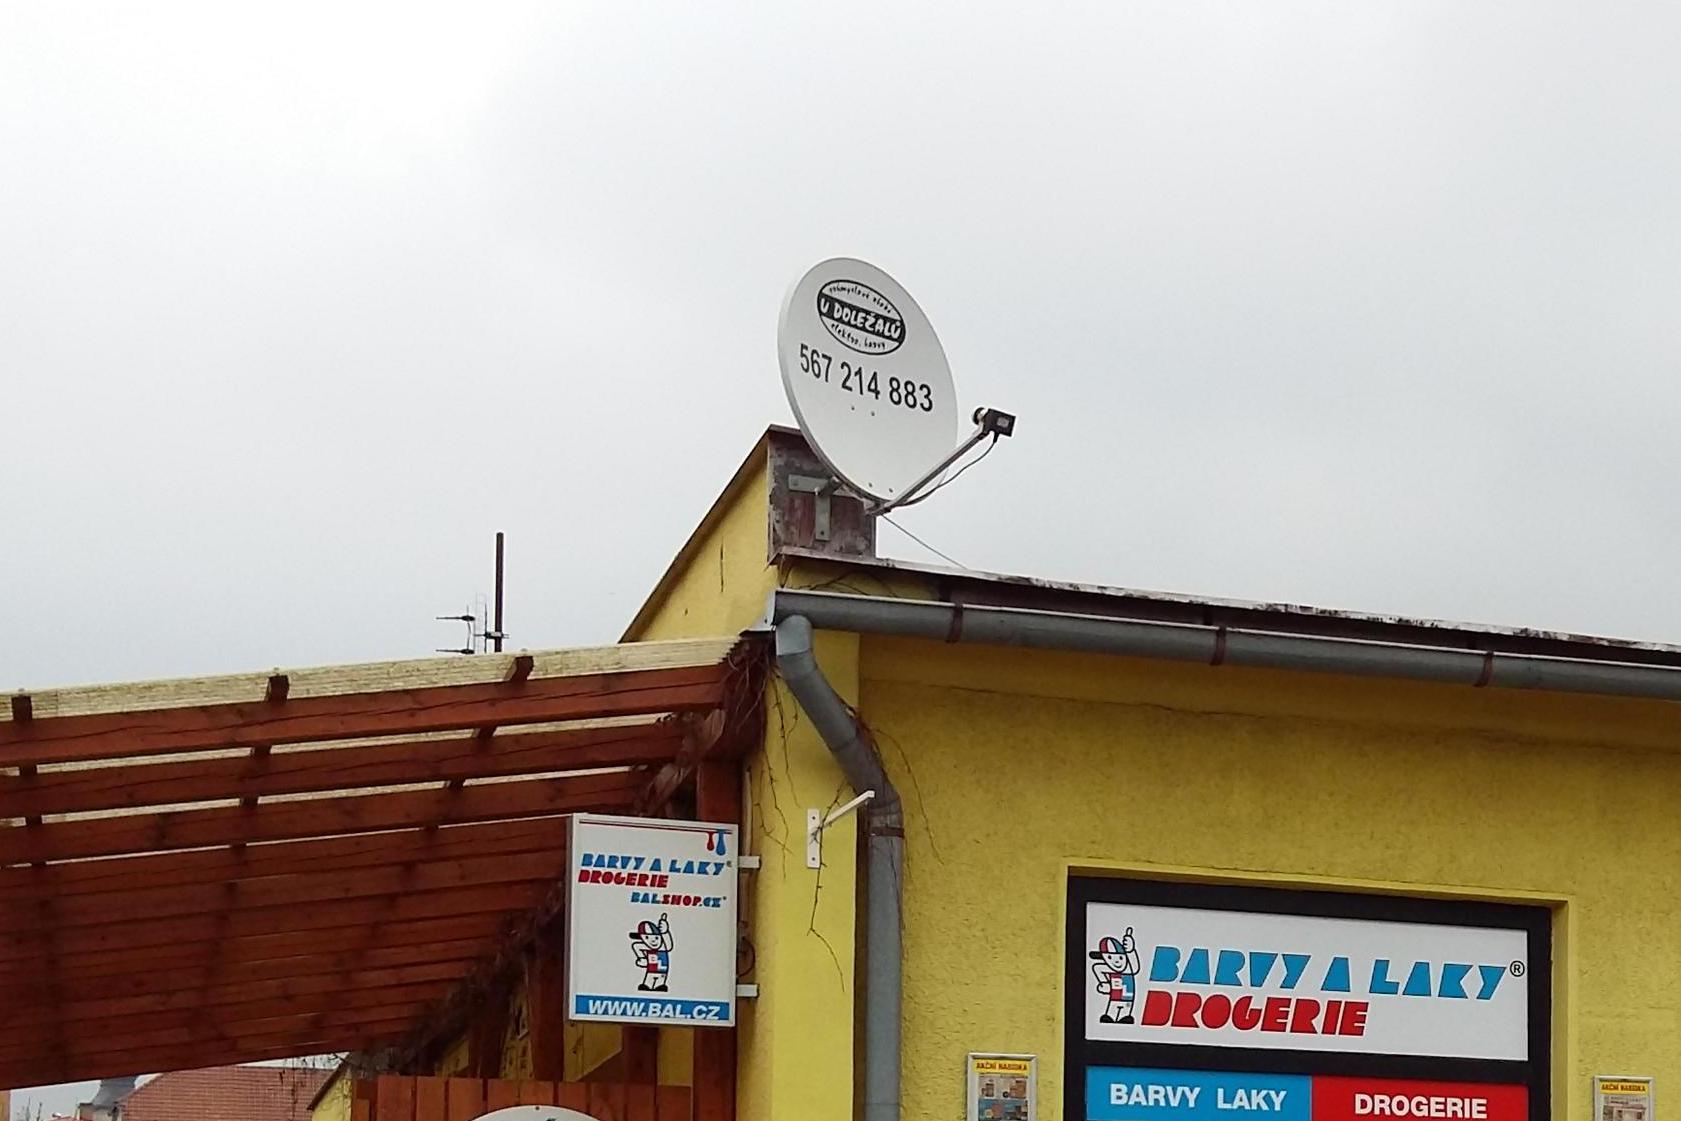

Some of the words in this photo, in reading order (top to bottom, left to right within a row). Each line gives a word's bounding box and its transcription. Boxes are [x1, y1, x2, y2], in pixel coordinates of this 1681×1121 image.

[820, 298, 830, 314] U
[800, 343, 832, 383] 567
[840, 361, 881, 400] 214
[888, 376, 933, 412] 883
[581, 853, 645, 870] BARVY
[649, 858, 663, 872] A
[578, 869, 669, 888] DROGERIE
[1149, 945, 1311, 989] BARVY
[1320, 956, 1351, 992] A
[588, 1000, 720, 1020] WWW.BAL.CZ
[1141, 990, 1369, 1037] DROGERIE
[1110, 1083, 1201, 1108] BARVY
[1216, 1088, 1287, 1112] LAKY
[1354, 1093, 1487, 1120] DROGERIE
